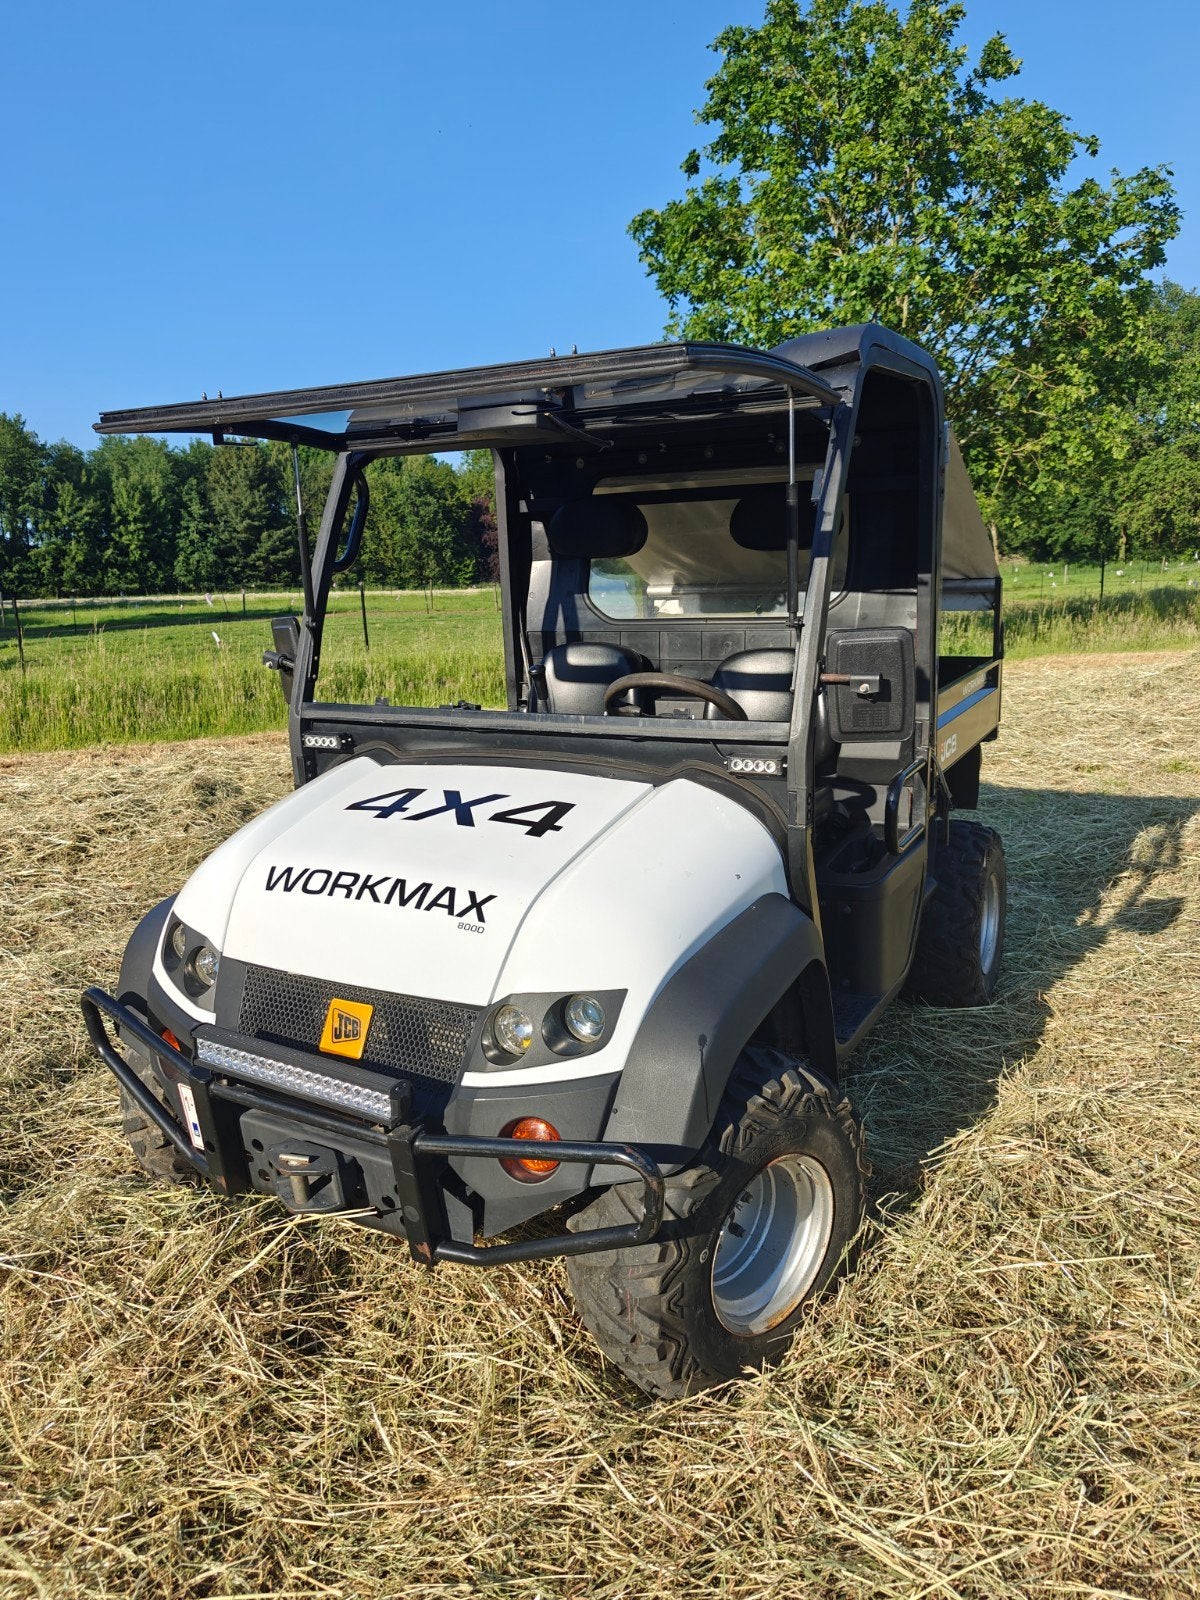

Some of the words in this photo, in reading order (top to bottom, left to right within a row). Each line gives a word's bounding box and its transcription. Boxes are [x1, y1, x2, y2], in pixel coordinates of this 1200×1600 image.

[941, 733, 957, 762] JCB
[343, 787, 577, 838] 4X4
[265, 865, 498, 924] WORKMAX
[334, 1012, 359, 1040] JCB
